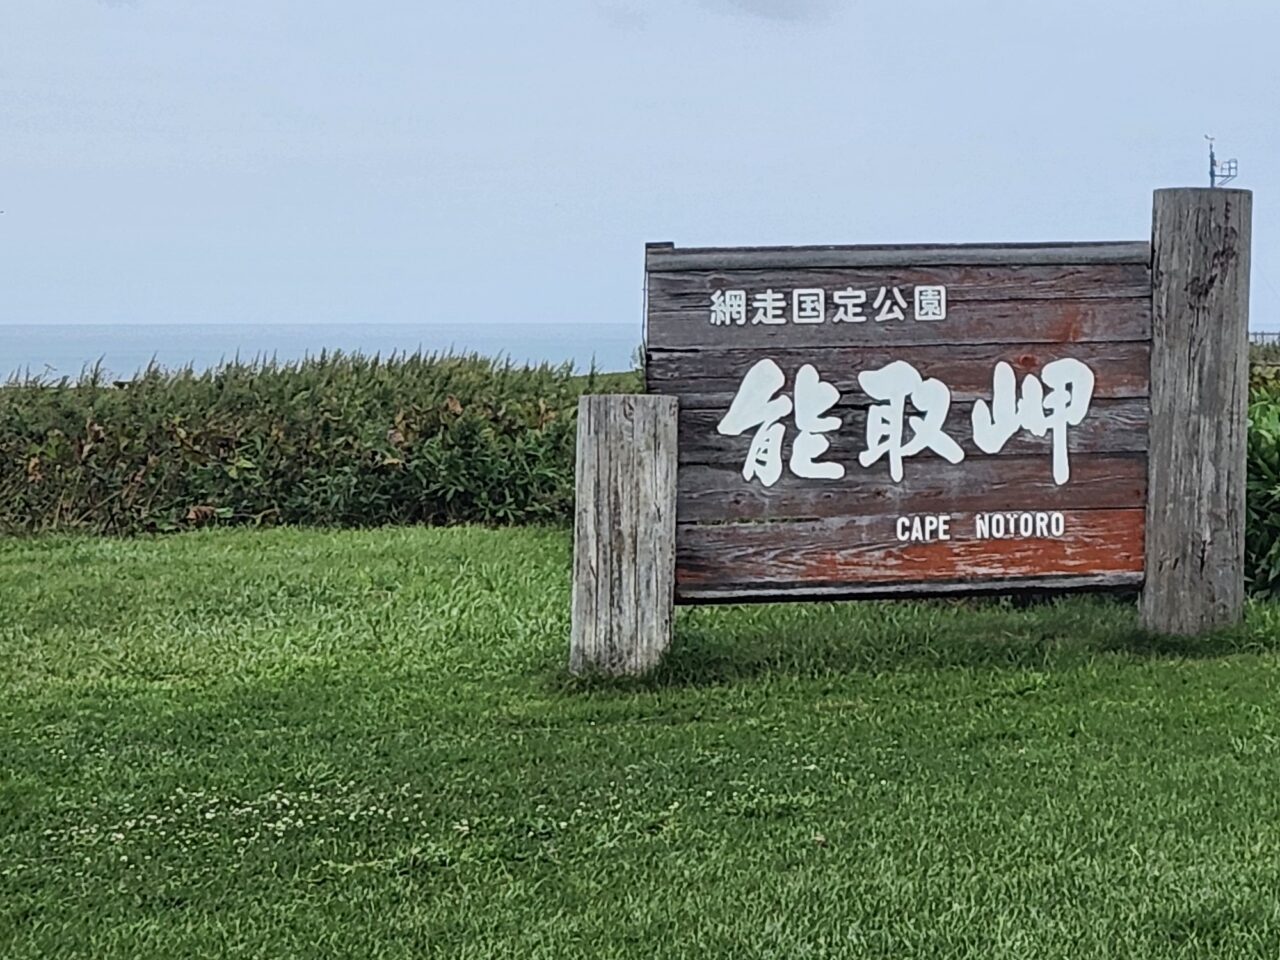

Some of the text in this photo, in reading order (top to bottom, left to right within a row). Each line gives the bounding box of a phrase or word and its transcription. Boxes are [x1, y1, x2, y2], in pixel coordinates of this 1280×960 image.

[710, 284, 947, 325] 網走国定公園
[717, 357, 1095, 487] 能取岬
[896, 512, 1065, 541] CAPE NOTORO
